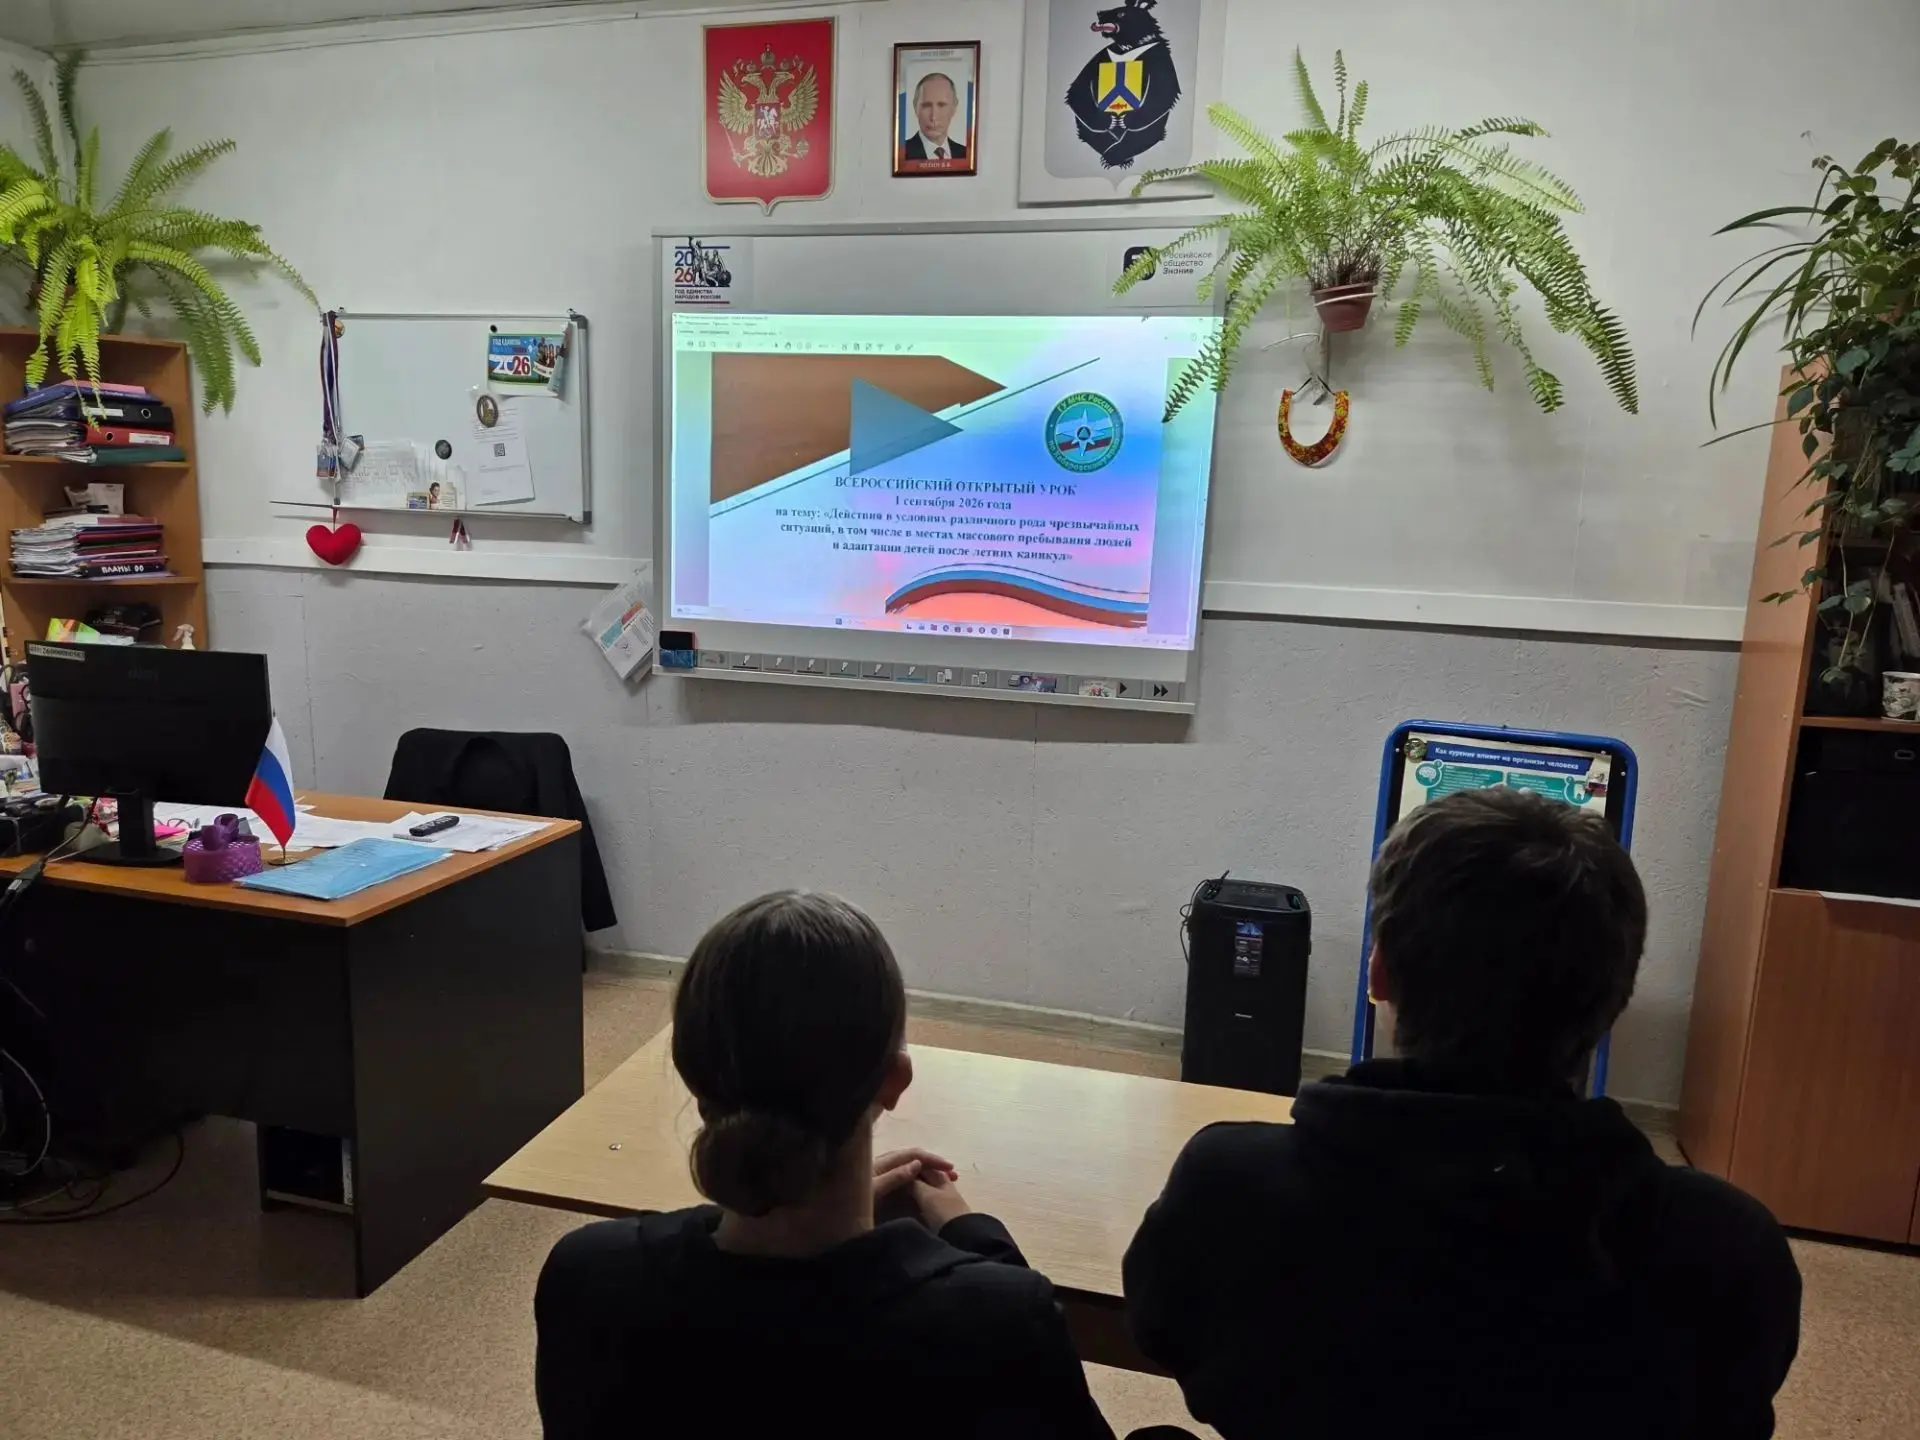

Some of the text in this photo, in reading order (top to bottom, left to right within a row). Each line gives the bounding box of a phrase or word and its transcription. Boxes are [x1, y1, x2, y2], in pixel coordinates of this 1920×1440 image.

[674, 250, 694, 267] 20
[1163, 259, 1203, 268] общество
[674, 267, 694, 283] 26
[1162, 267, 1194, 275] Знание
[834, 476, 1078, 496] ВСЕРОССИЙСКИЙ ОТКРЫТЫЙ УРОК
[895, 495, 1012, 511] 1 сентября 2026 года
[775, 508, 1141, 532] на тему: «Действия в условиях различного рода чрезвычайных
[780, 522, 1133, 548] ситуаций, в том числе в местах массового пребывания людей
[832, 542, 1073, 563] и адаптации детей после летних каникул»
[101, 564, 132, 574] ПЛАНЫ
[1435, 747, 1447, 755] Как
